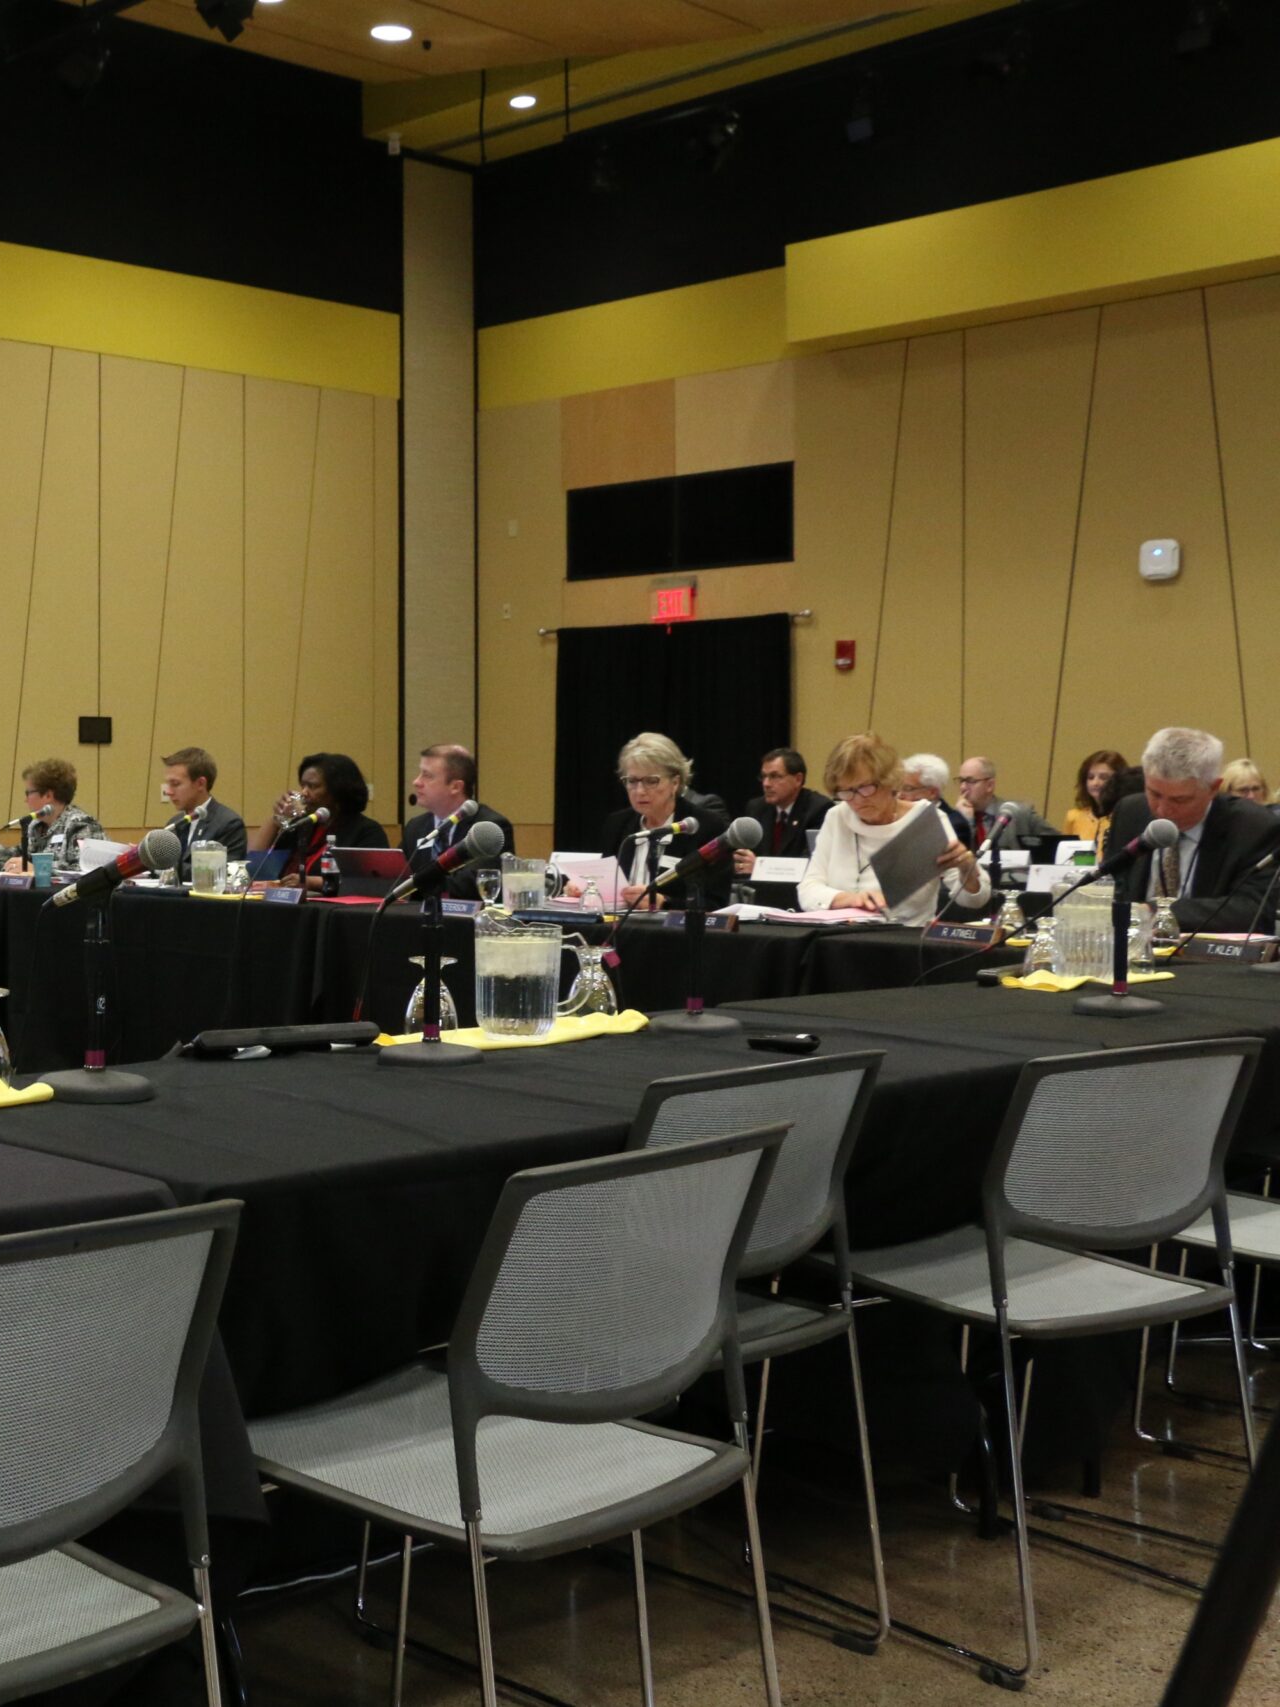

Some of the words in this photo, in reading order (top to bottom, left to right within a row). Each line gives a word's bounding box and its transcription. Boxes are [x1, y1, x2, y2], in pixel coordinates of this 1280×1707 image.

[658, 590, 684, 617] EXIT
[441, 902, 467, 912] ETERSON
[951, 928, 977, 939] ATWELL
